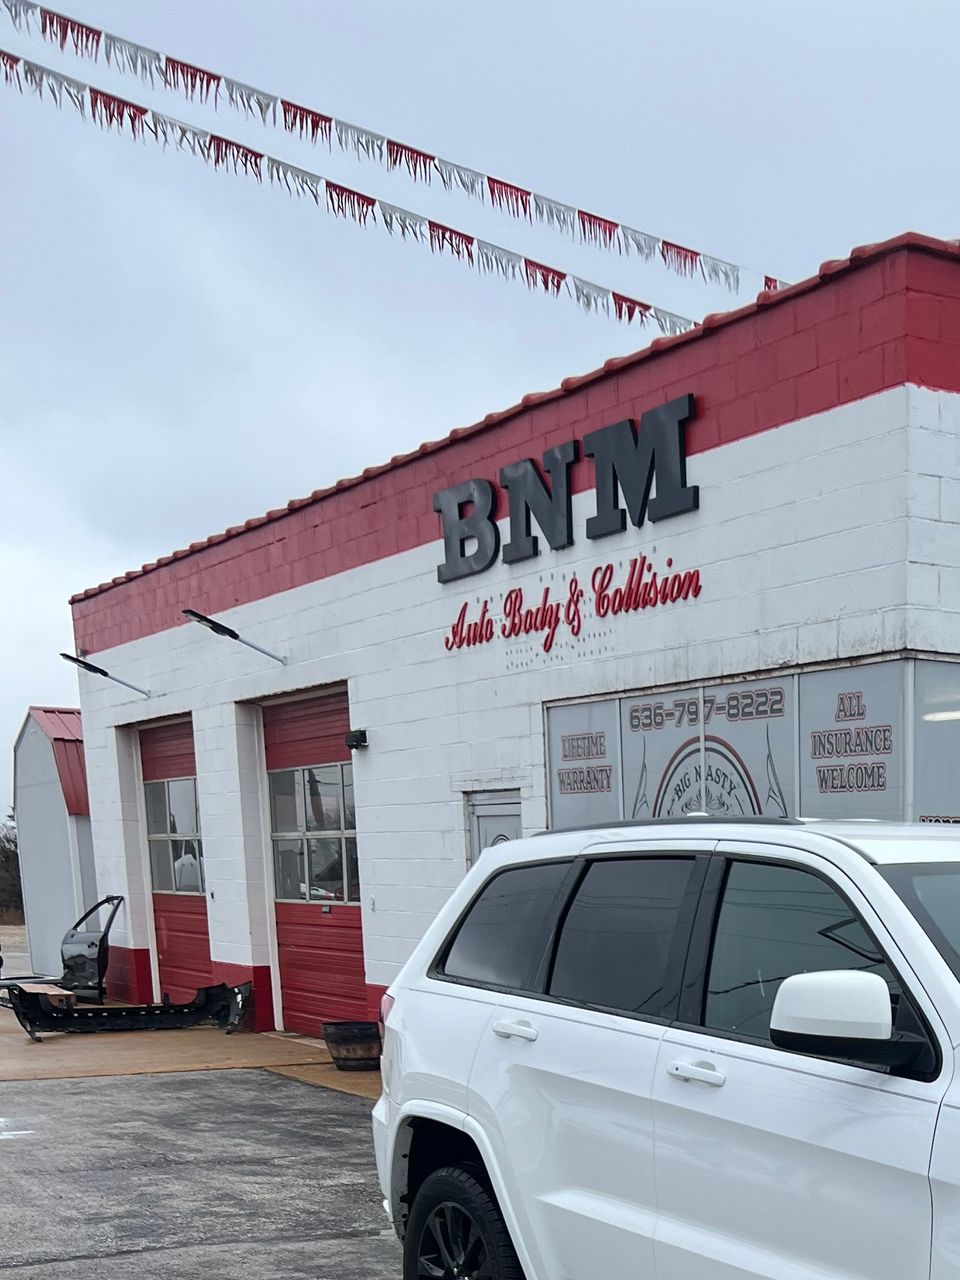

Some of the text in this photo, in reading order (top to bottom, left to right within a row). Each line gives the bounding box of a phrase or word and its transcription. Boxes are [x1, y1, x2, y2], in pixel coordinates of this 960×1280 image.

[433, 393, 699, 584] BNM
[445, 556, 702, 653] Auto Body & Collision
[630, 687, 784, 731] 636-797-8222
[836, 693, 865, 720] ALL
[562, 734, 606, 760] LIFETIME
[811, 727, 891, 757] INSURANCE
[558, 767, 612, 793] WARRANTY
[674, 765, 737, 800] BIG NASTY
[817, 764, 885, 791] WELCOME
